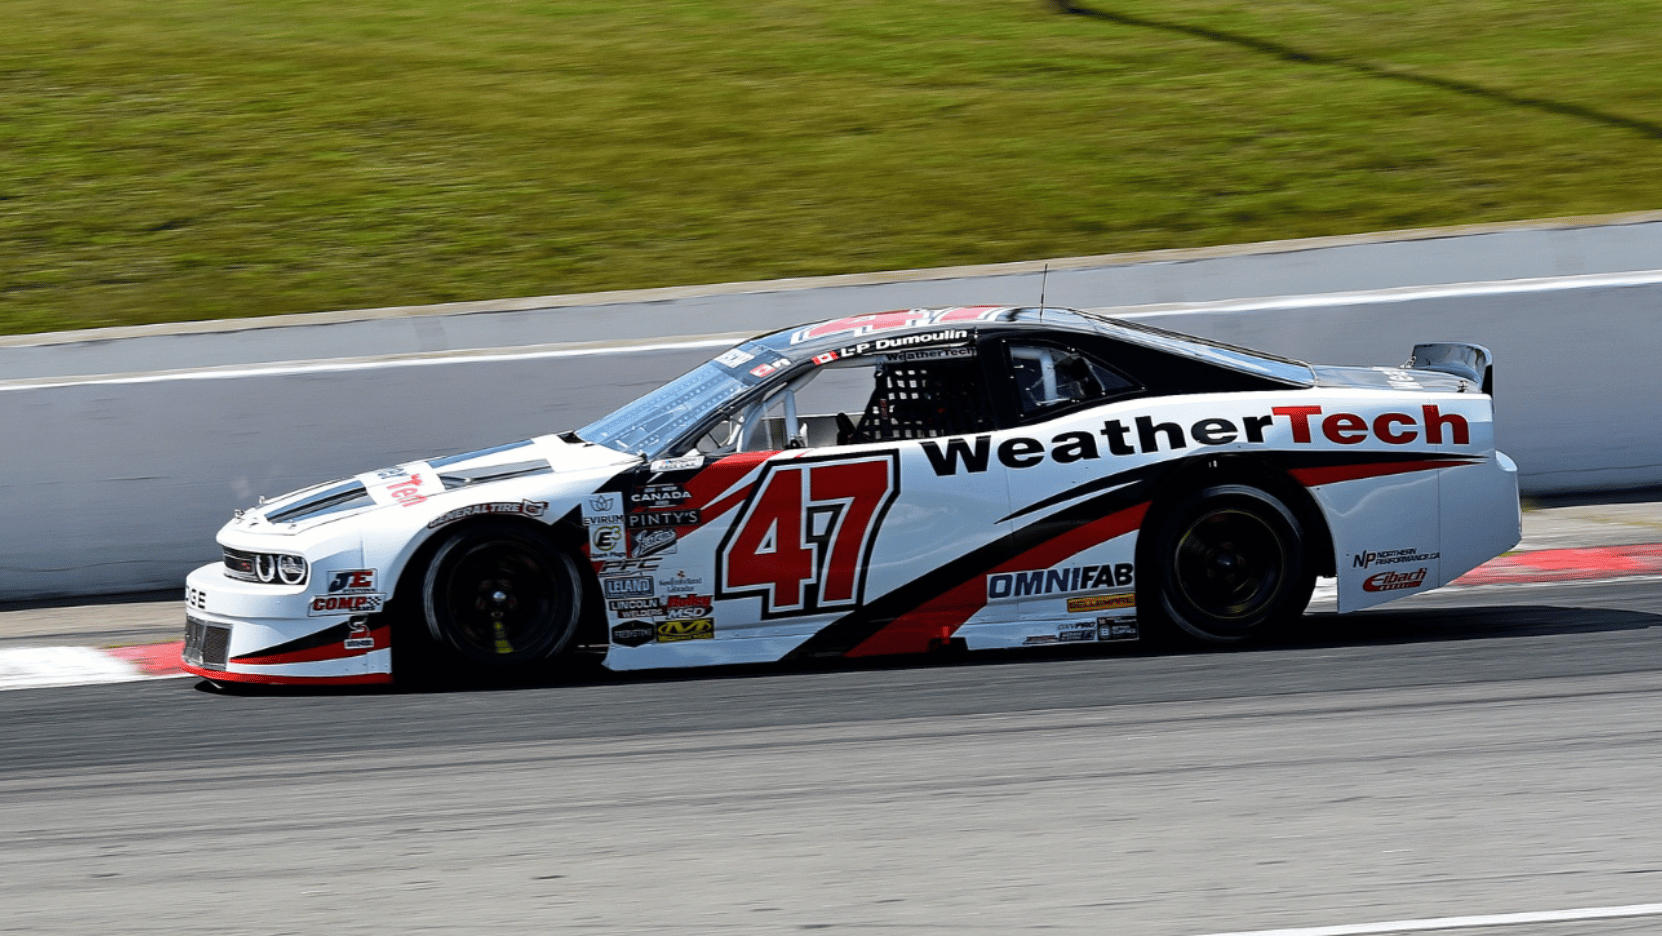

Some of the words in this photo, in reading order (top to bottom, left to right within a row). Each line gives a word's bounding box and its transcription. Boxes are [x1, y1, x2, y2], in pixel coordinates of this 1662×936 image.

[876, 328, 968, 351] Dumoulin
[921, 404, 1470, 477] WeatherTech
[631, 491, 692, 502] CANADA
[490, 502, 520, 512] TIRE
[630, 510, 698, 527] PINTY'S
[722, 454, 894, 614] 47
[1353, 550, 1376, 569] NP
[1377, 548, 1417, 558] NORTHERN
[328, 571, 373, 592] JE
[608, 579, 650, 592] LELAND
[989, 563, 1134, 599] OMNIFAB
[1363, 567, 1428, 592] Eibach
[313, 596, 367, 611] COMP
[611, 599, 658, 609] LINCOLN
[666, 607, 707, 619] MSD
